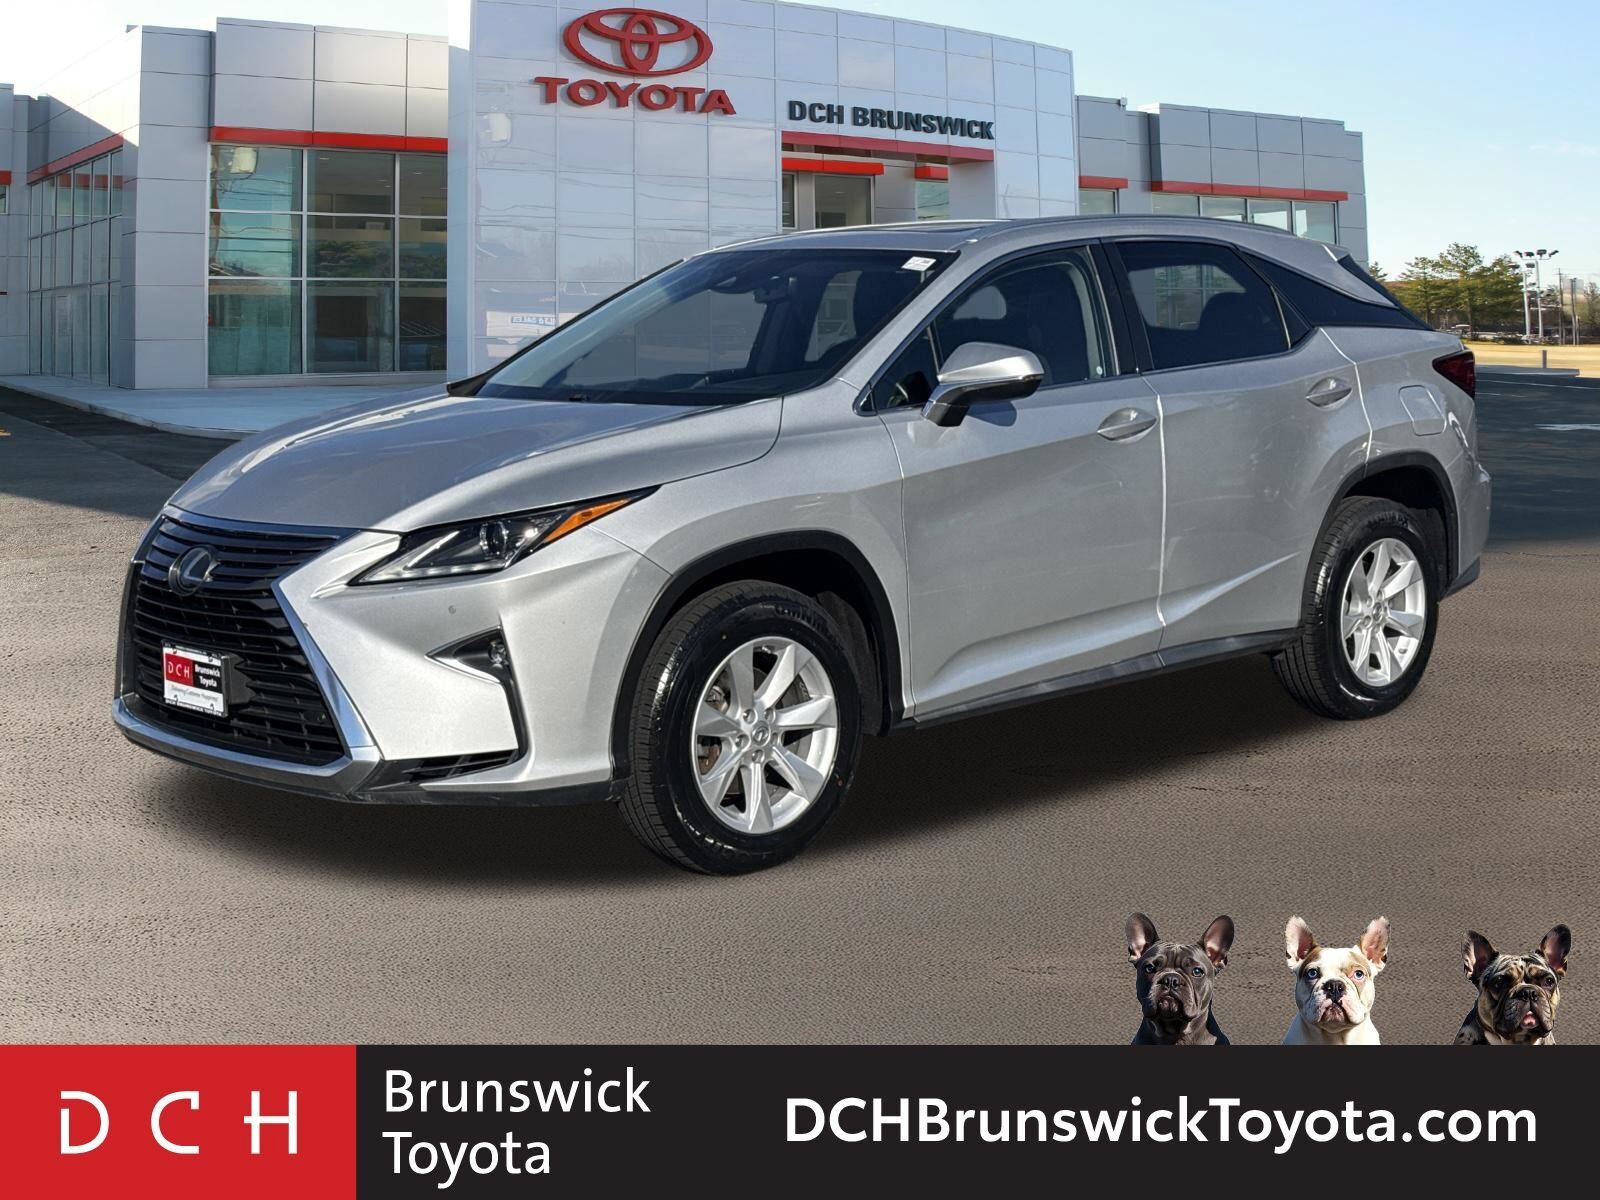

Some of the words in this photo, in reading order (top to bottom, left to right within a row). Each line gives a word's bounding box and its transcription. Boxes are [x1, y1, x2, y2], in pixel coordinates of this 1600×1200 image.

[534, 76, 737, 115] TOYOTA
[788, 100, 845, 124] DCH
[851, 106, 995, 140] BRUNSWICK
[168, 661, 190, 679] DCH
[194, 664, 220, 677] Brunswick
[199, 675, 217, 688] Toyota
